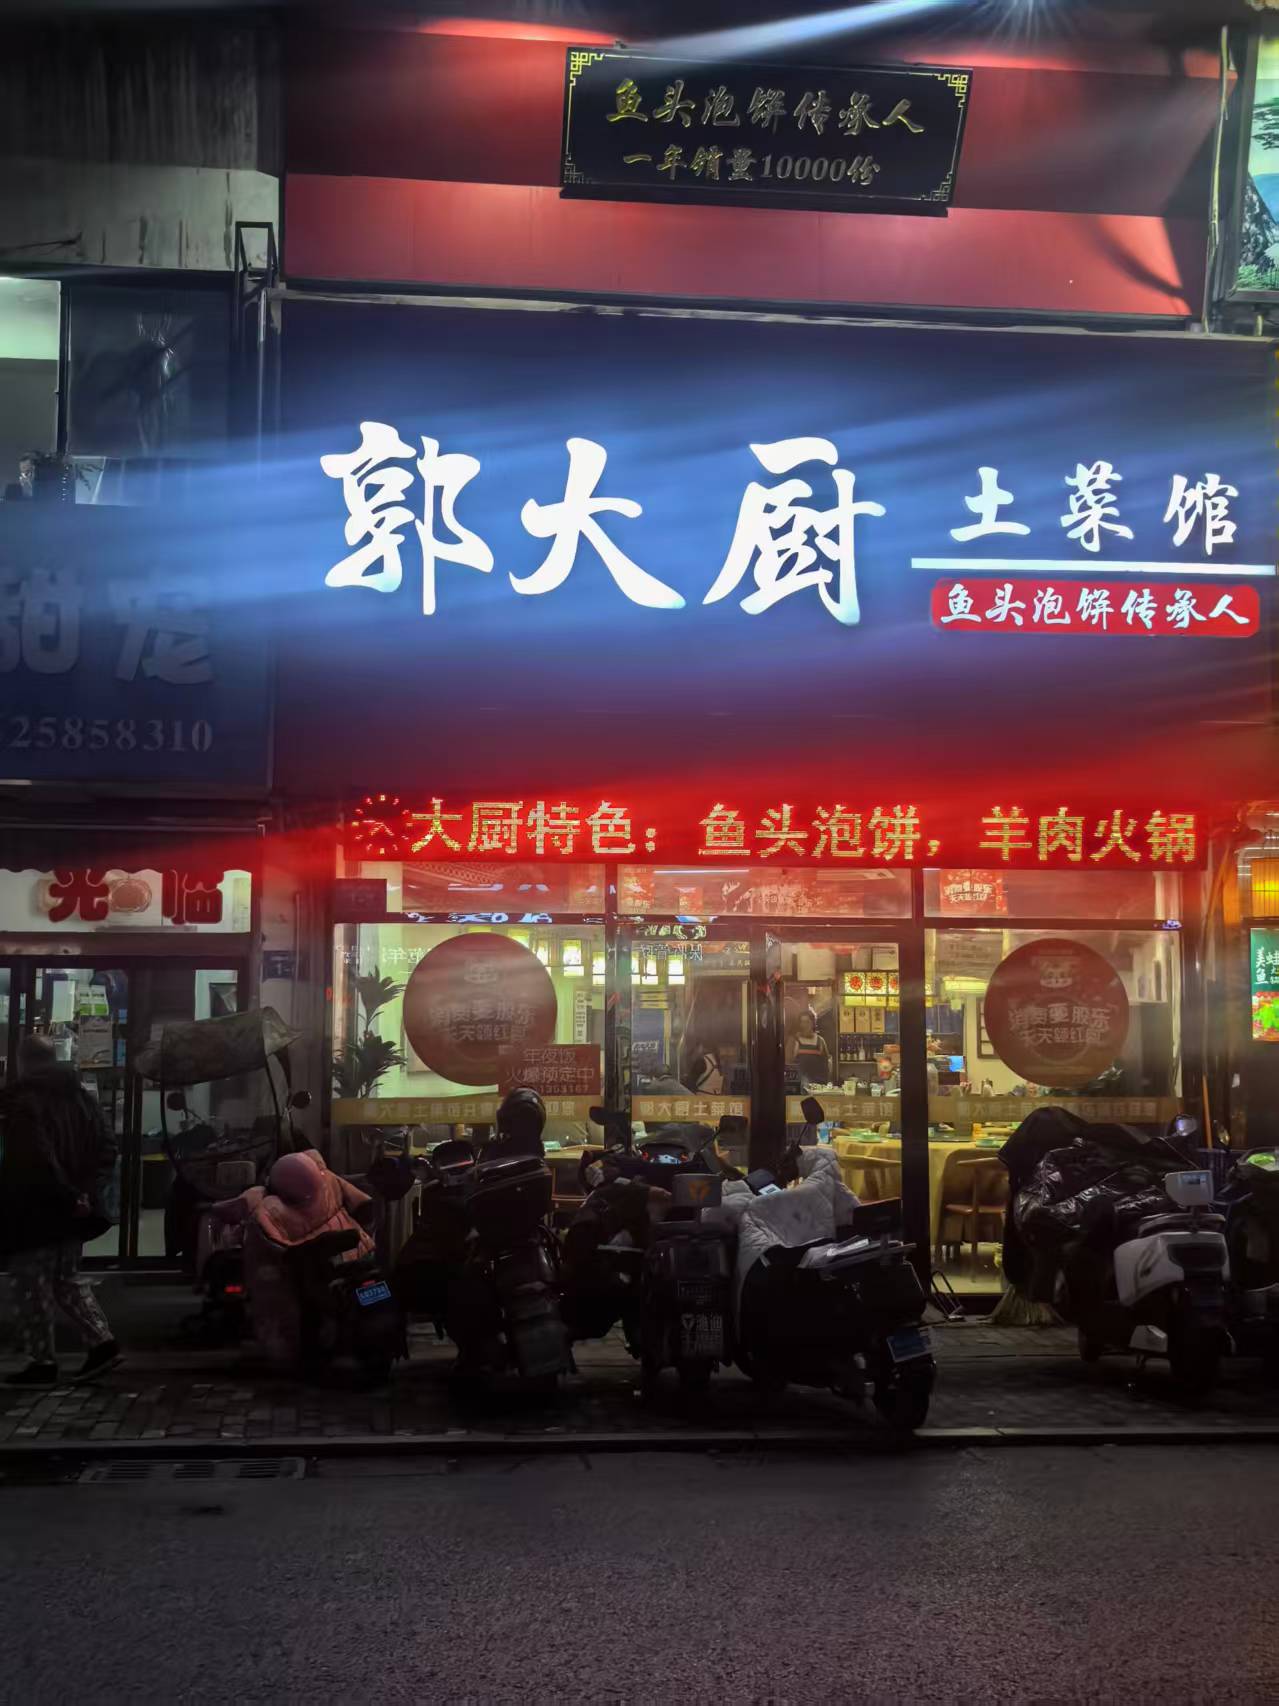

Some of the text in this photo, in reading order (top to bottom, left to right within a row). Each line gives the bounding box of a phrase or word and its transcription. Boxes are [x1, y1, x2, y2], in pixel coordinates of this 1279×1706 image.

[606, 78, 926, 136] 鱼头泡饼传承人
[622, 144, 881, 186] 一年销量10000份
[320, 421, 887, 626] 郭大厨
[949, 460, 1240, 556] 土菜馆
[941, 583, 1251, 630] 鱼头泡饼传承人
[979, 805, 1196, 863] 羊肉火锅
